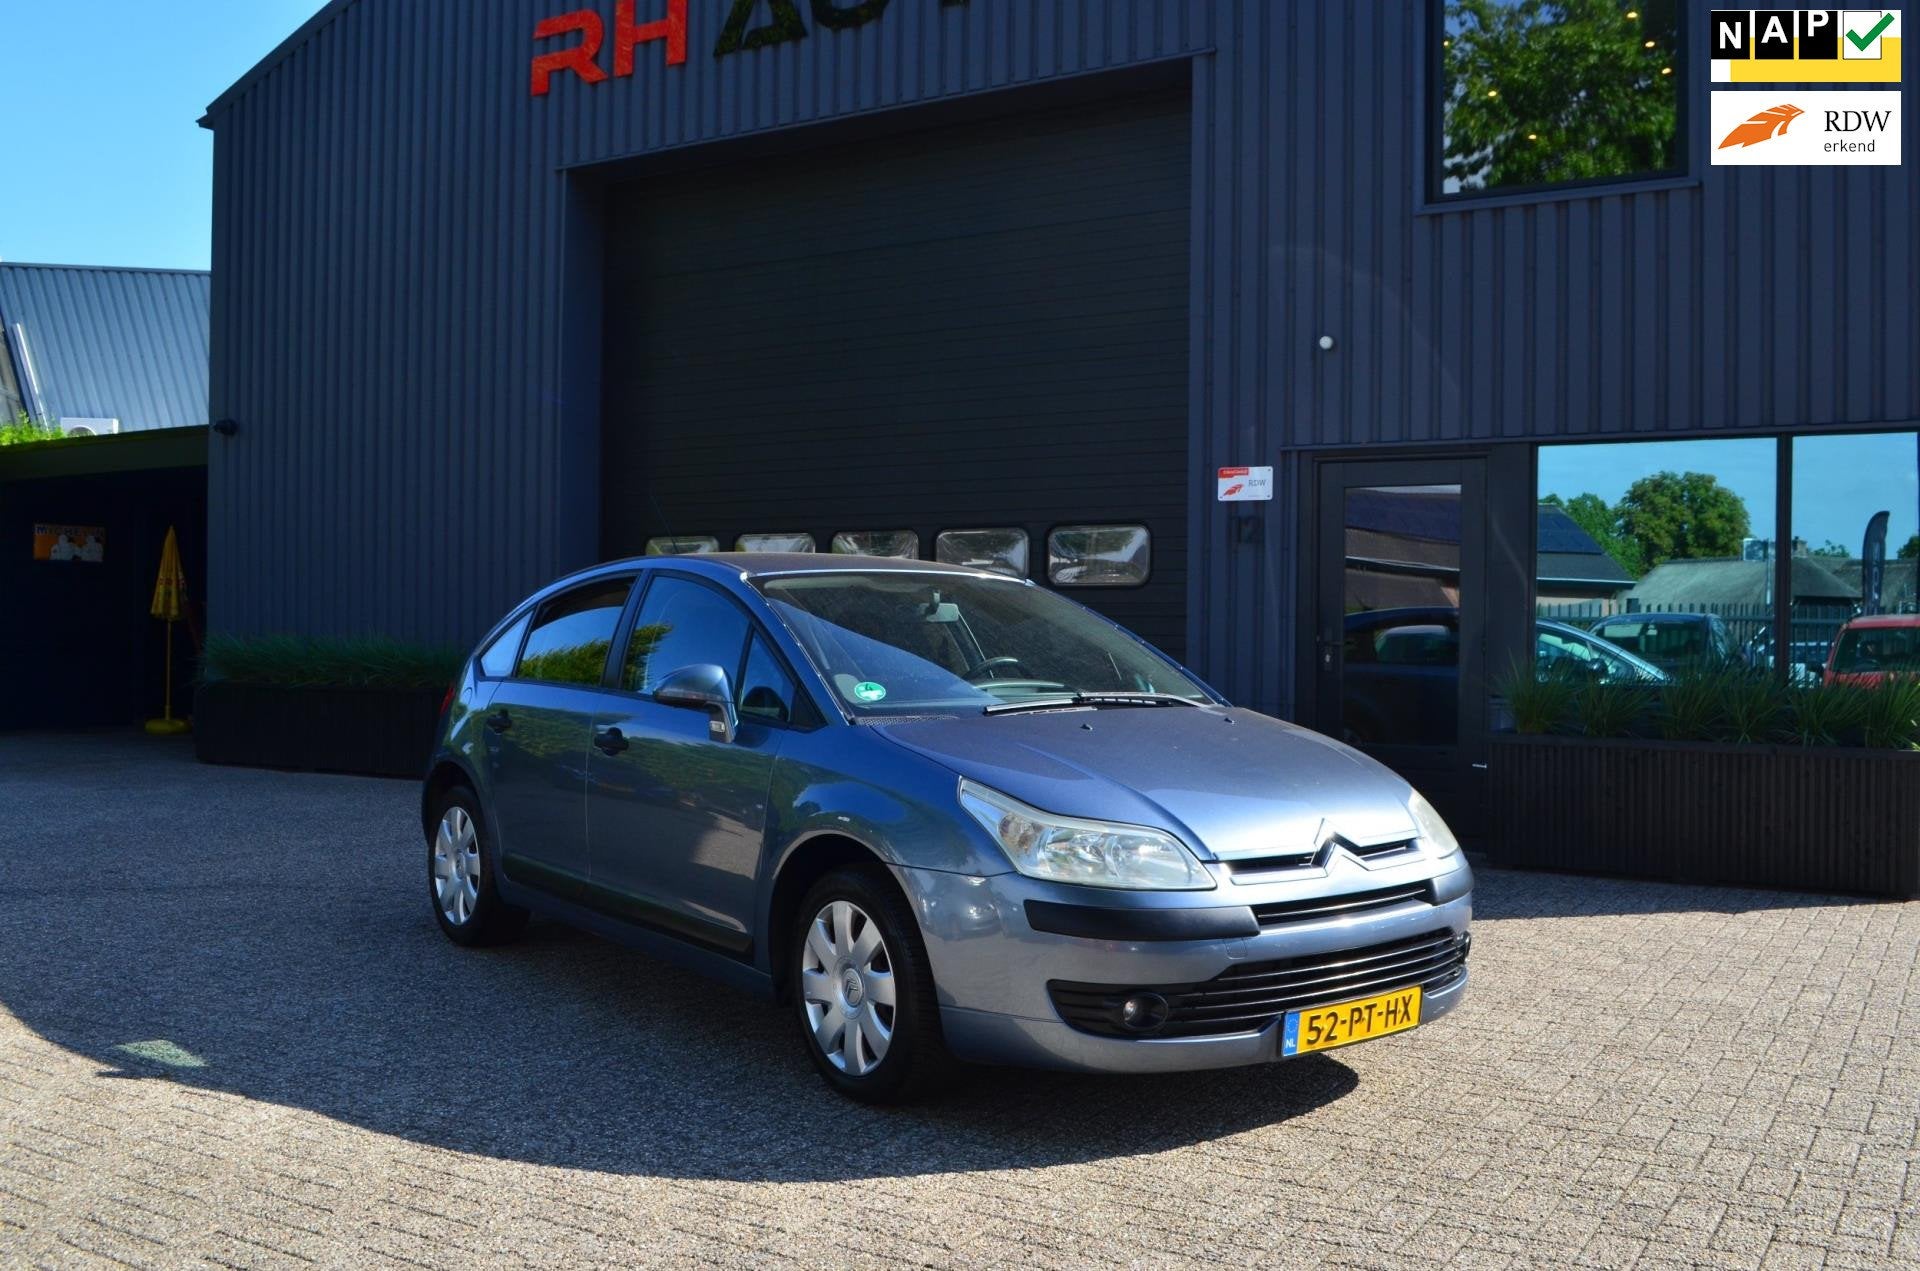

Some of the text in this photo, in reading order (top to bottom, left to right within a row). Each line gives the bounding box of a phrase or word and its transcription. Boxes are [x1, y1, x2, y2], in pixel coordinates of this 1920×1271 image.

[530, 0, 687, 96] RH
[1285, 1039, 1296, 1049] NL
[1306, 994, 1413, 1045] 52-PT-HX
